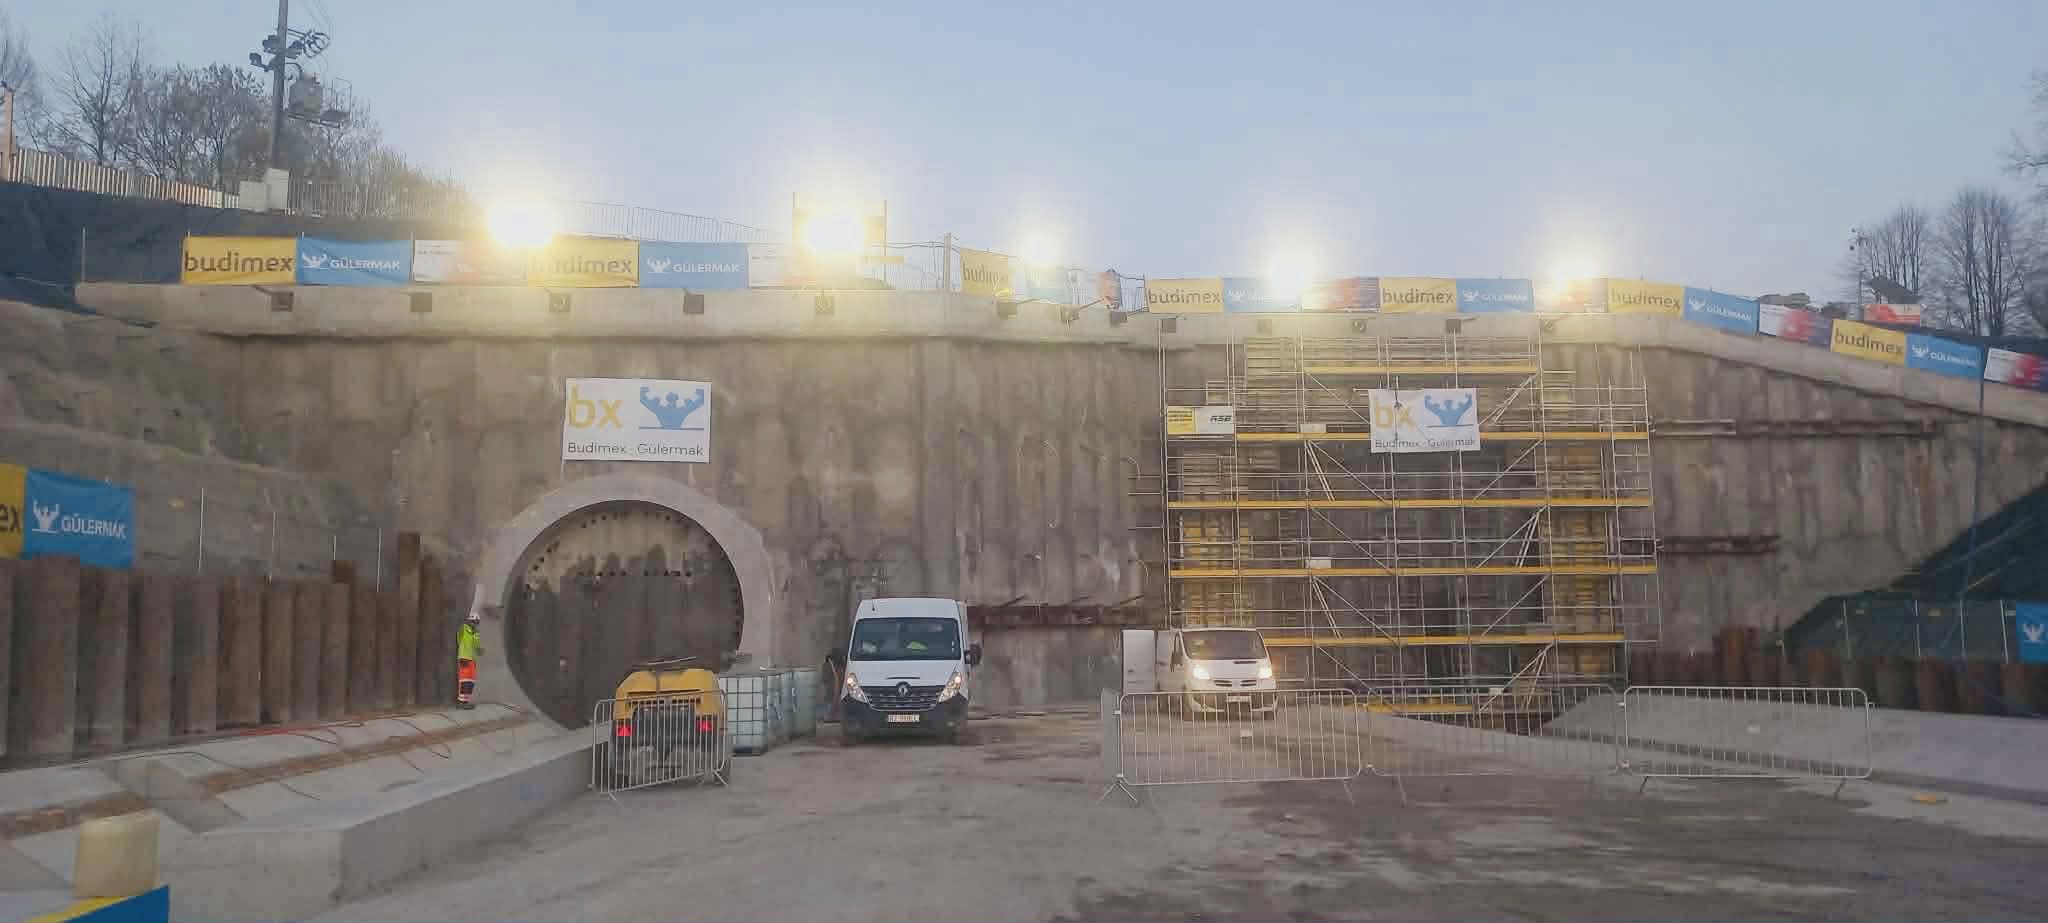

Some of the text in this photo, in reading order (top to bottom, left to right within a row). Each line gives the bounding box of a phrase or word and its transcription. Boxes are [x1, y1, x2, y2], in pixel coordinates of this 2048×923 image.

[184, 251, 294, 272] budimex
[1148, 287, 1221, 304] budimex
[1382, 287, 1456, 304] budimex
[1611, 287, 1681, 312] budimex
[1835, 327, 1904, 354] budimex
[568, 383, 624, 429] bx
[1375, 395, 1416, 429] bx
[568, 441, 625, 454] Budimex
[61, 512, 127, 539] GÜLERMAK
